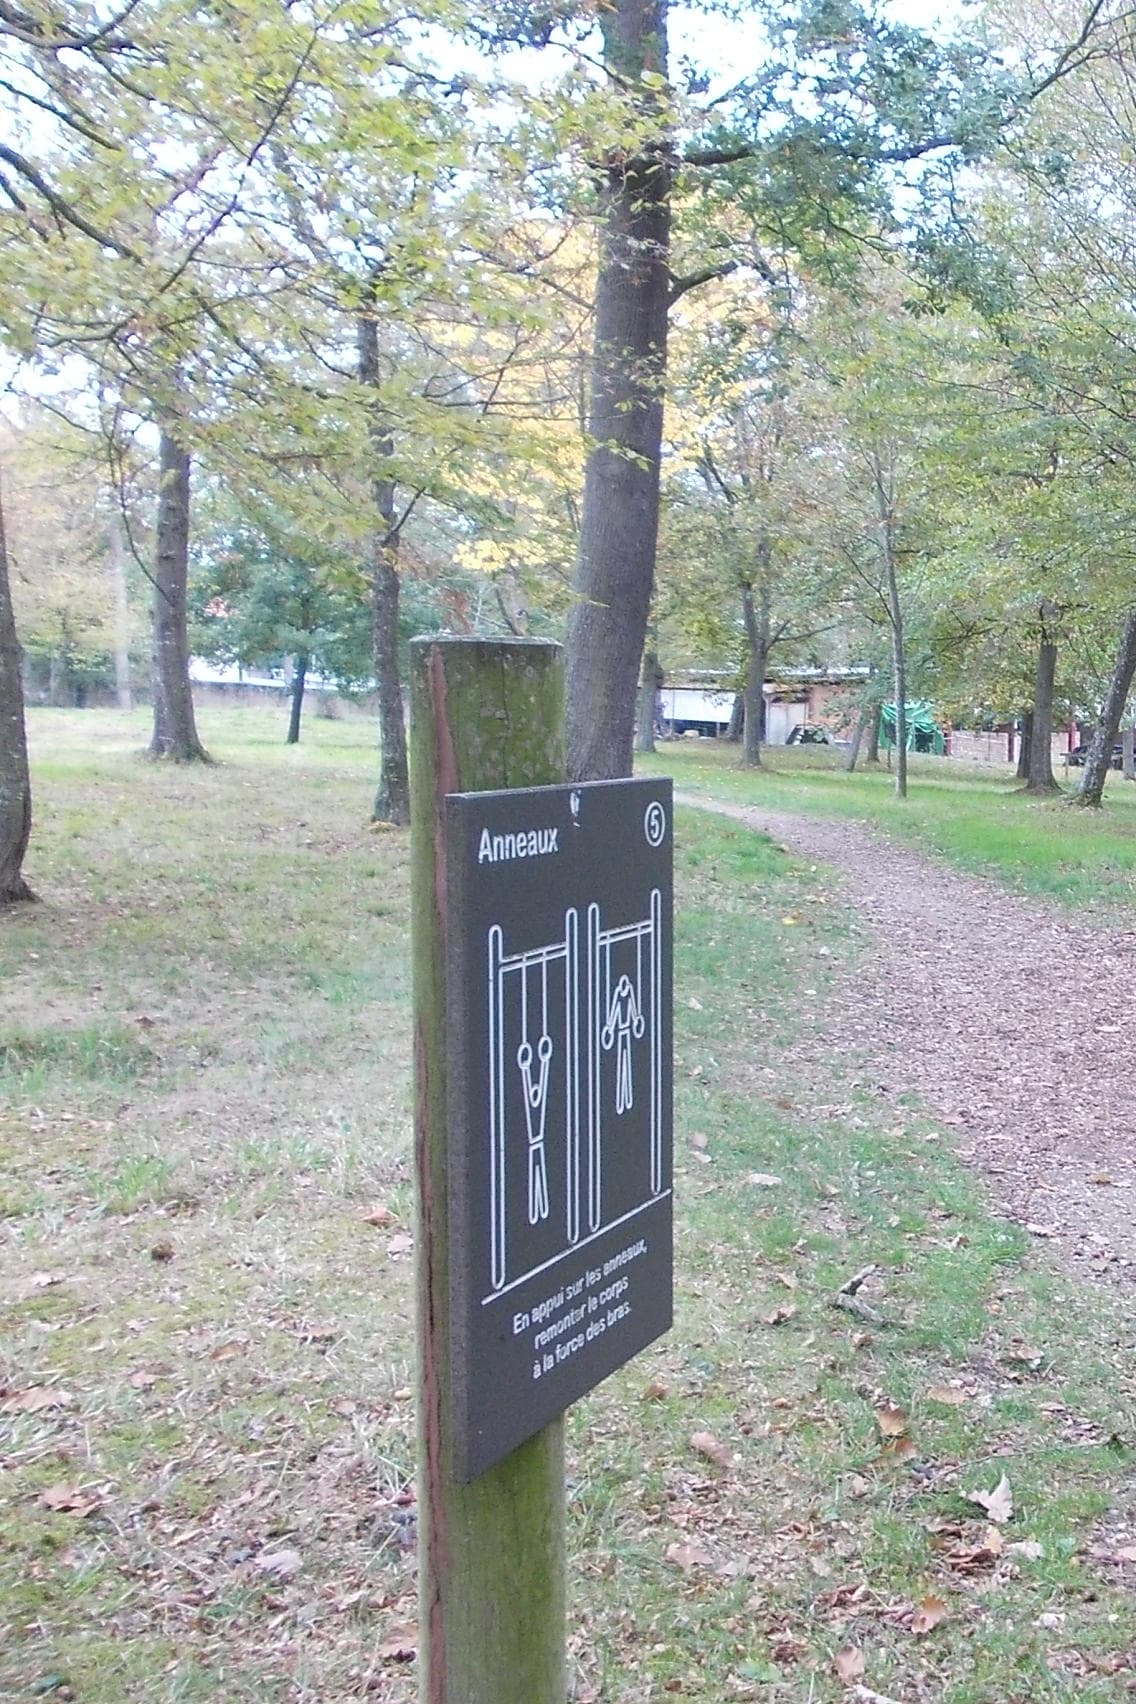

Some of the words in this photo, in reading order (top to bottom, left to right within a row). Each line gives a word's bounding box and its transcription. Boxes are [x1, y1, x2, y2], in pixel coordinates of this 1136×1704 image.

[478, 827, 559, 864] Anneaux
[650, 809, 660, 839] 5
[512, 1312, 530, 1335] En
[531, 1287, 565, 1323] appui
[566, 1277, 585, 1301] sur
[585, 1268, 602, 1287] les
[534, 1301, 587, 1350] remonter
[587, 1295, 598, 1314] le
[599, 1276, 629, 1306] corps
[532, 1360, 542, 1380] à
[543, 1353, 555, 1372] la
[555, 1334, 585, 1364] force
[586, 1317, 606, 1341] des
[606, 1301, 632, 1327] bras.
